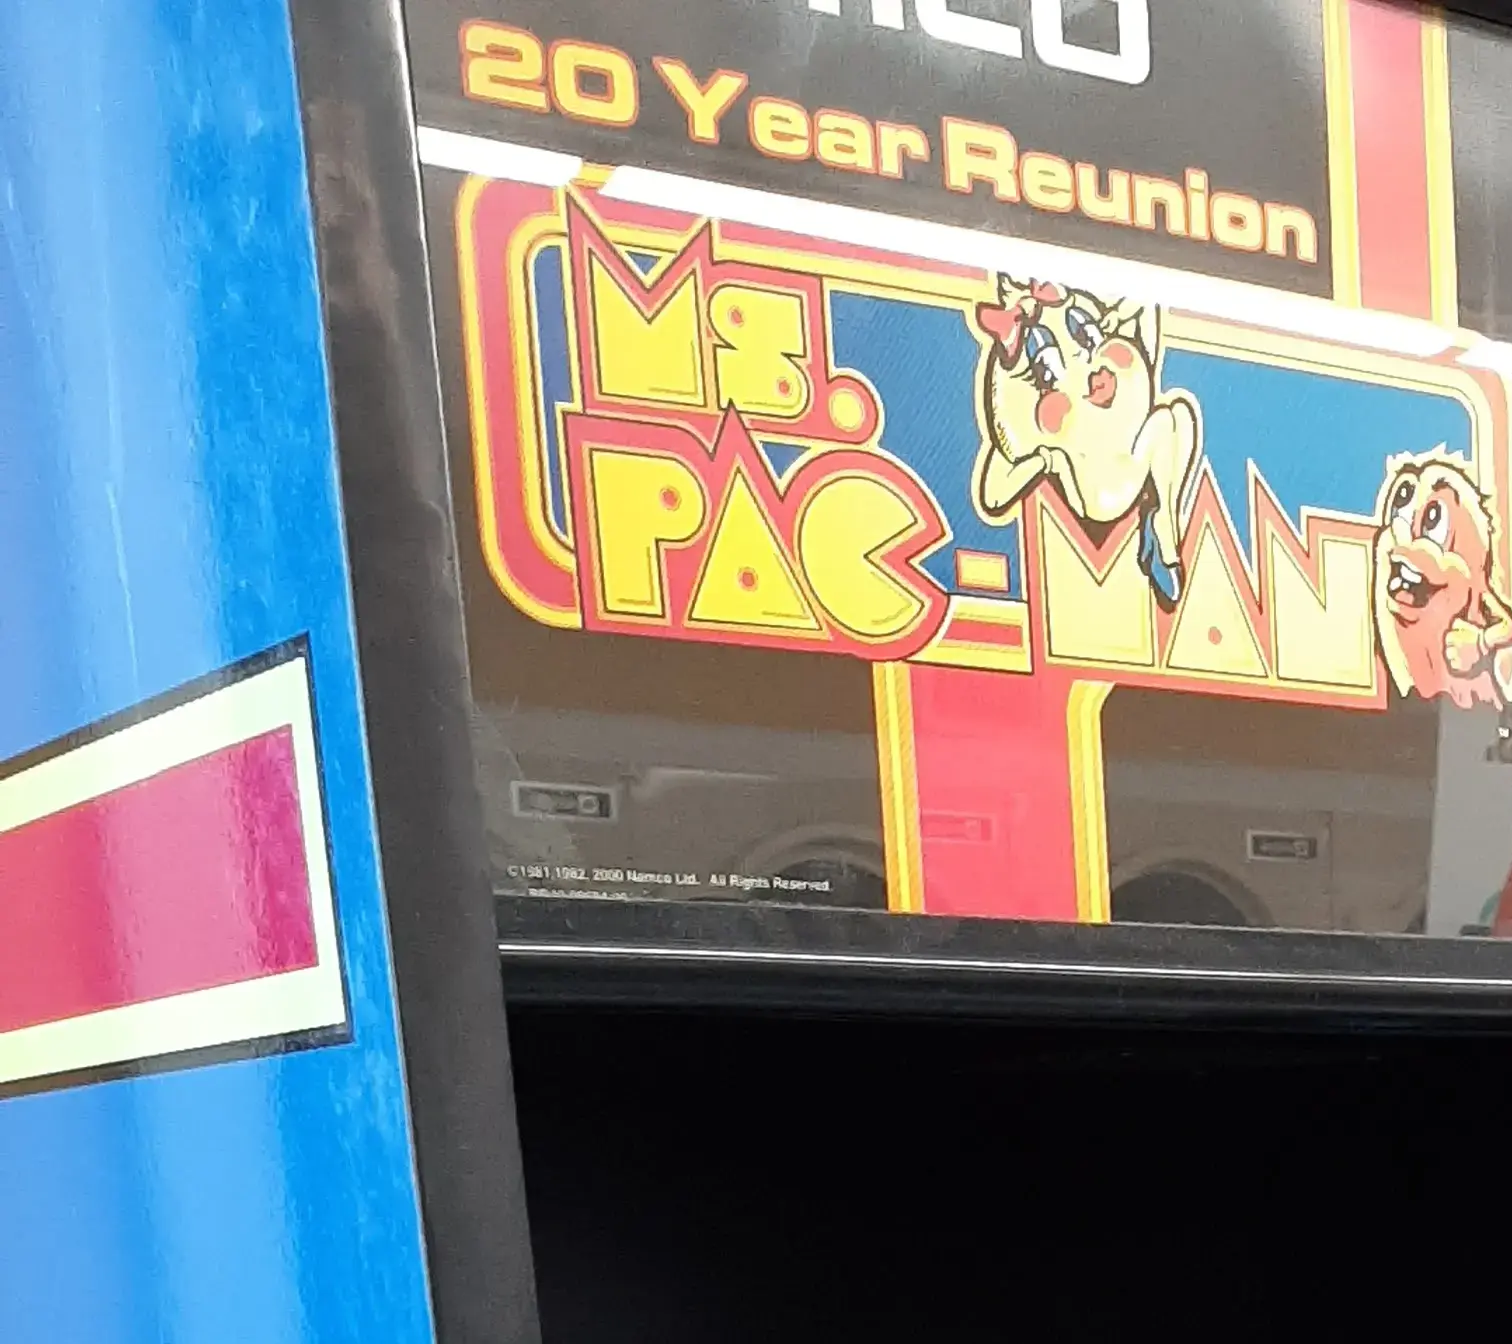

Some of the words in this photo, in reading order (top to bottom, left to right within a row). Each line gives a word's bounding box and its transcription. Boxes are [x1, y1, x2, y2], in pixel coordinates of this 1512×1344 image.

[458, 19, 639, 127] 20
[654, 55, 930, 180] Year
[941, 115, 1318, 263] Reunion
[709, 874, 727, 887] All
[729, 874, 771, 891] Rights
